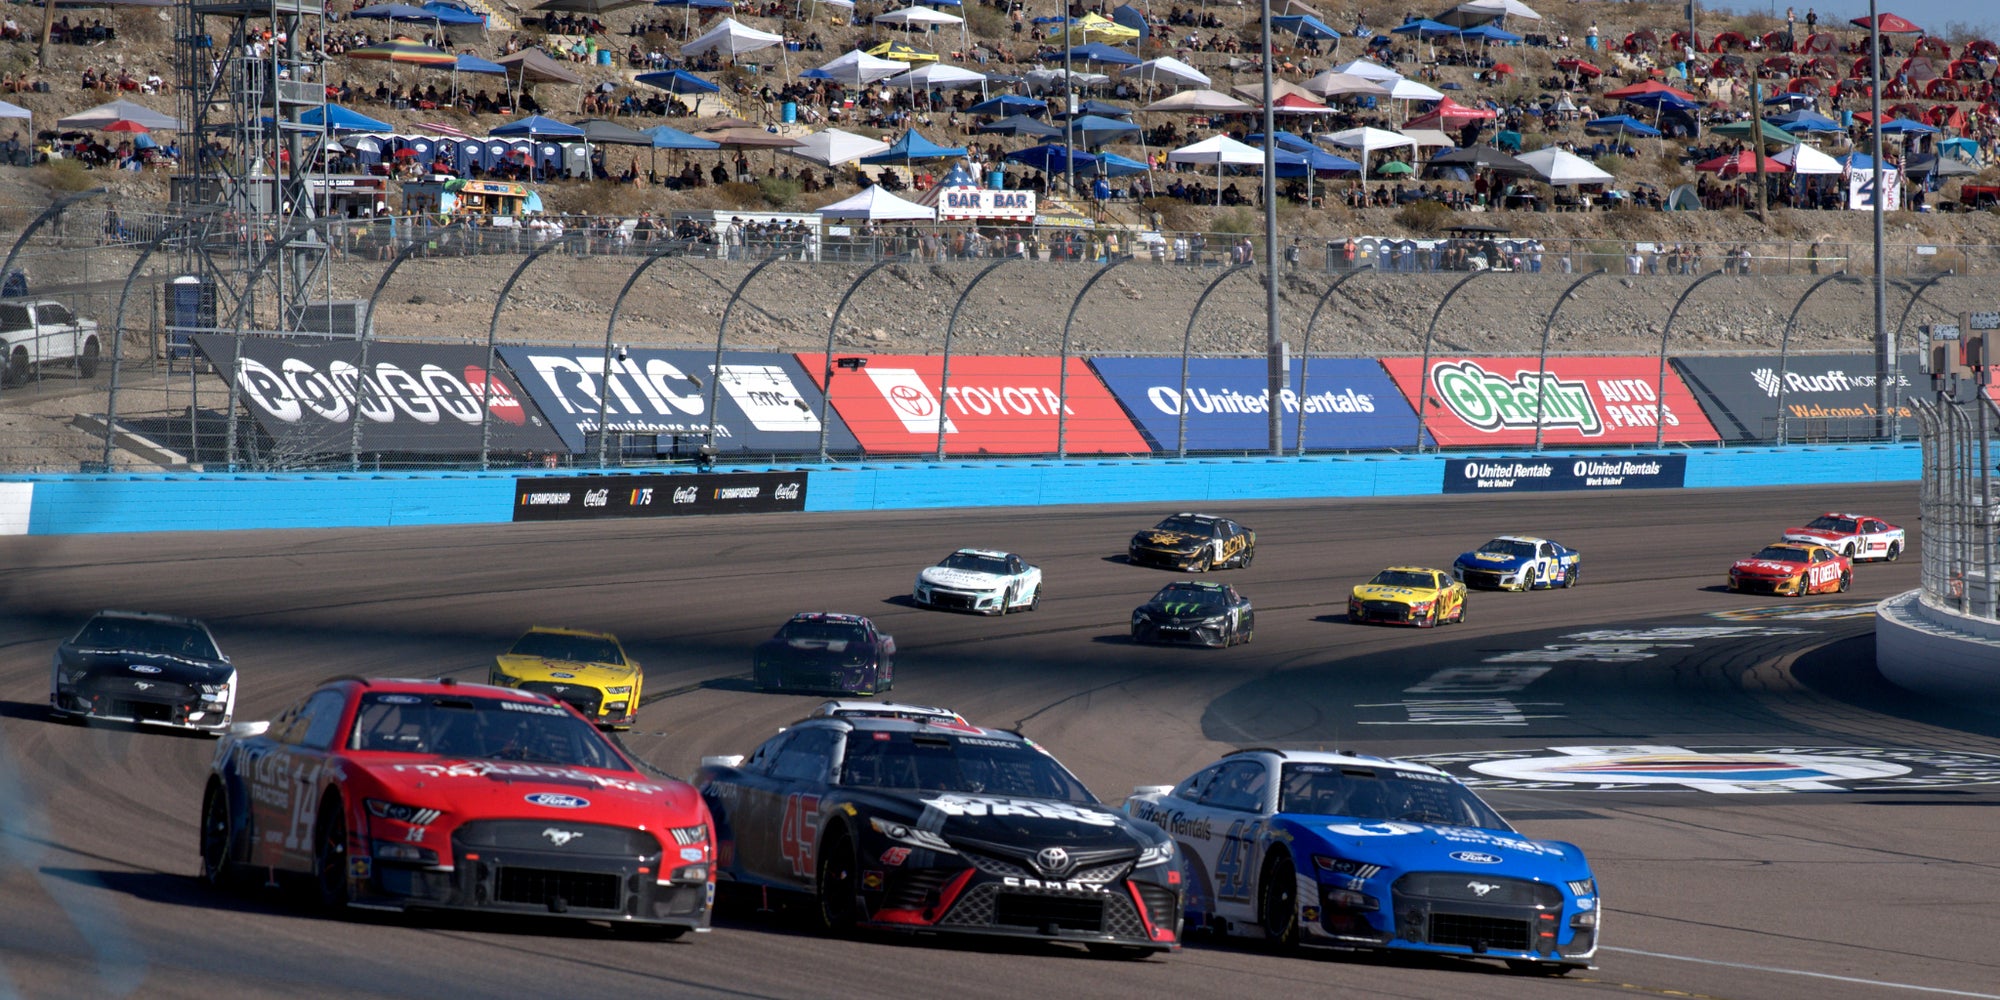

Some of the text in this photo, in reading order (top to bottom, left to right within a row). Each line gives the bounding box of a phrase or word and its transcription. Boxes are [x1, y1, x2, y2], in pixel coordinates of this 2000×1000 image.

[1852, 171, 1867, 182] FAN
[1887, 173, 1895, 207] EVER
[947, 192, 1029, 209] BAR BAR
[526, 355, 706, 415] RTIC
[1783, 370, 1851, 393] Ruoff
[747, 390, 789, 407] RTIC
[1438, 367, 1597, 430] O'Reilly
[1596, 379, 1657, 403] AUTO
[938, 386, 1076, 416] TOYOTA
[1185, 387, 1376, 414] United Rentals
[1604, 404, 1680, 428] PARTS
[1788, 403, 1865, 418] Welcome
[1478, 463, 1552, 479] United Rentals
[1587, 461, 1660, 476] United Rentals
[1477, 479, 1514, 488] Work United
[1586, 476, 1623, 486] Work United
[529, 492, 571, 506] CHAMPIONSHIP
[639, 488, 653, 505] 75
[721, 486, 760, 500] CHAMPIONSHIP
[1535, 561, 1547, 580] 9
[500, 701, 569, 718] BRISCOE
[957, 736, 1022, 750] REDDICK
[1395, 771, 1451, 784] PREECE
[285, 762, 323, 850] 14
[1170, 810, 1212, 841] Rentals
[404, 826, 426, 843] 14
[780, 793, 822, 878] 45
[880, 847, 912, 866] 45
[1003, 876, 1104, 893] CAMRY
[1346, 878, 1365, 892] 41
